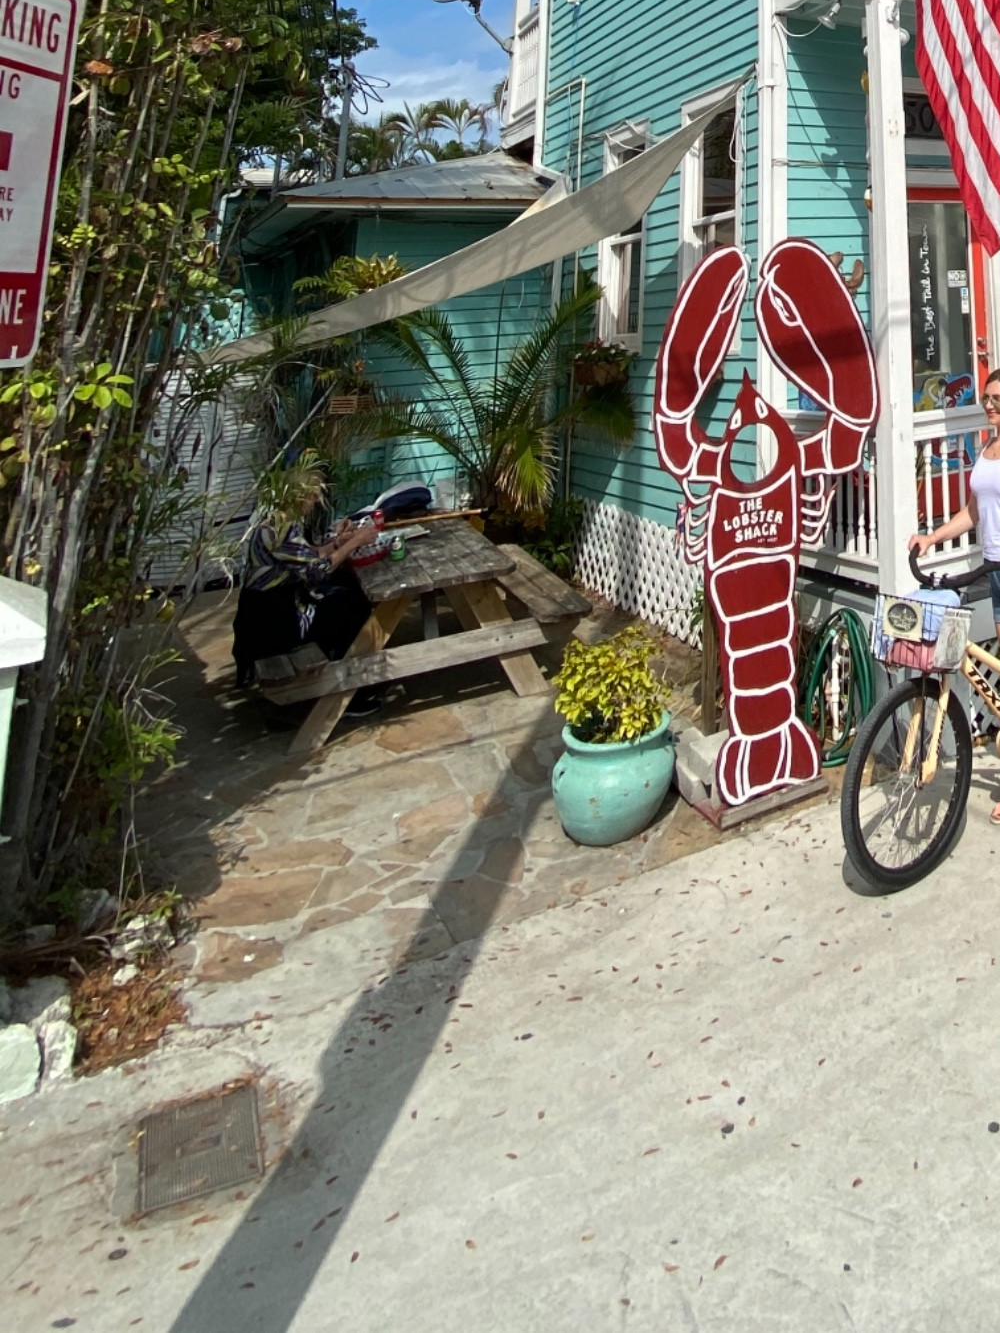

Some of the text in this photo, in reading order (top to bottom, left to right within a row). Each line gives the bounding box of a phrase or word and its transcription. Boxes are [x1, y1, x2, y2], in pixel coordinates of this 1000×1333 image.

[920, 276, 932, 304] Tail
[921, 305, 936, 333] Best
[925, 334, 936, 361] The
[739, 497, 763, 514] THE
[723, 509, 784, 532] LOBSTER
[735, 523, 778, 543] SHACK
